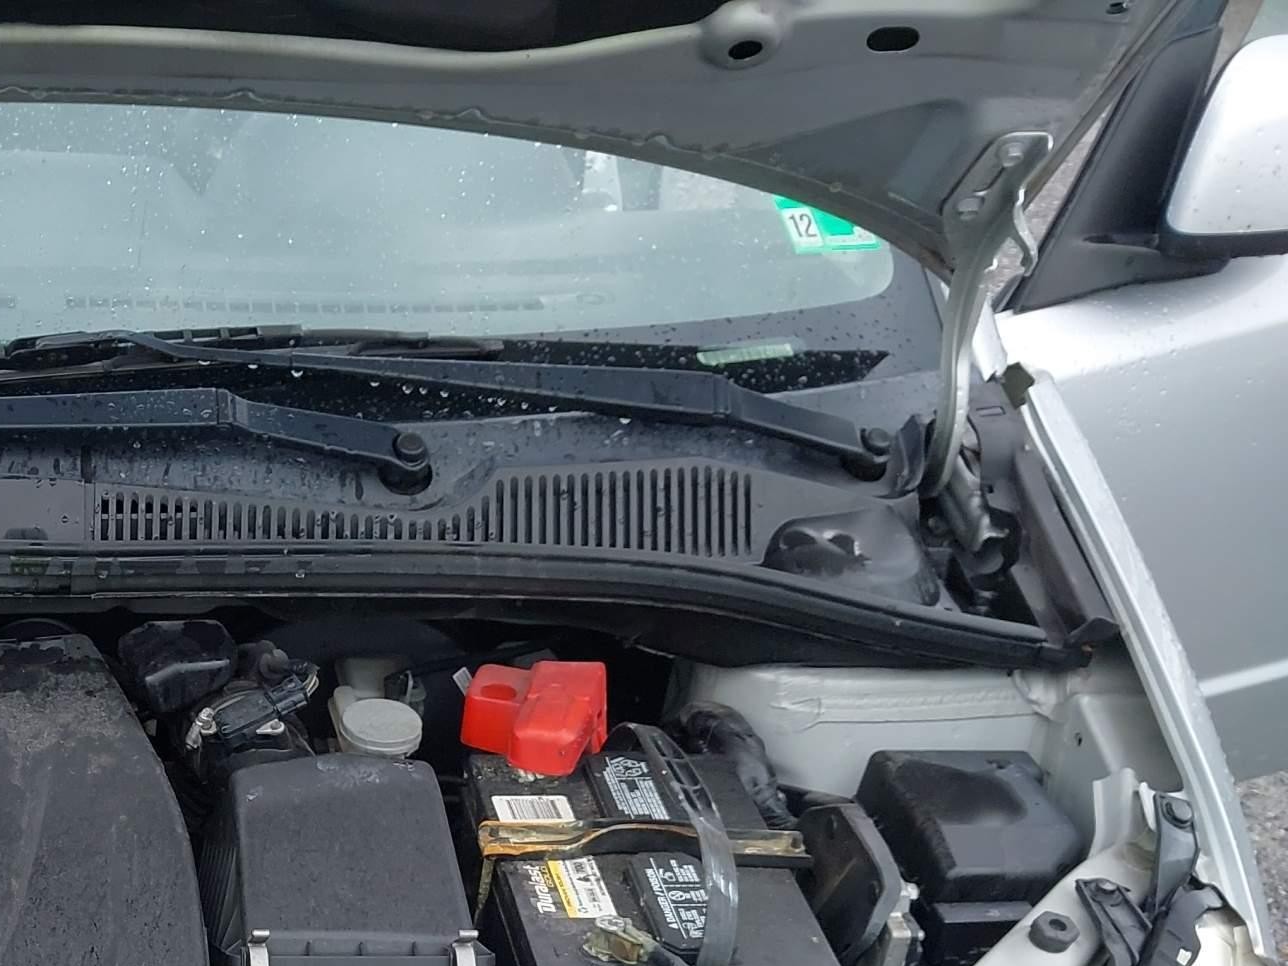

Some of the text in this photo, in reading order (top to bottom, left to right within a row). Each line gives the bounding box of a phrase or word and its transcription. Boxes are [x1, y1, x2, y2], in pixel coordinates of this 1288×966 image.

[788, 213, 818, 238] 12
[522, 863, 557, 914] Duralast
[657, 896, 676, 922] DANGER
